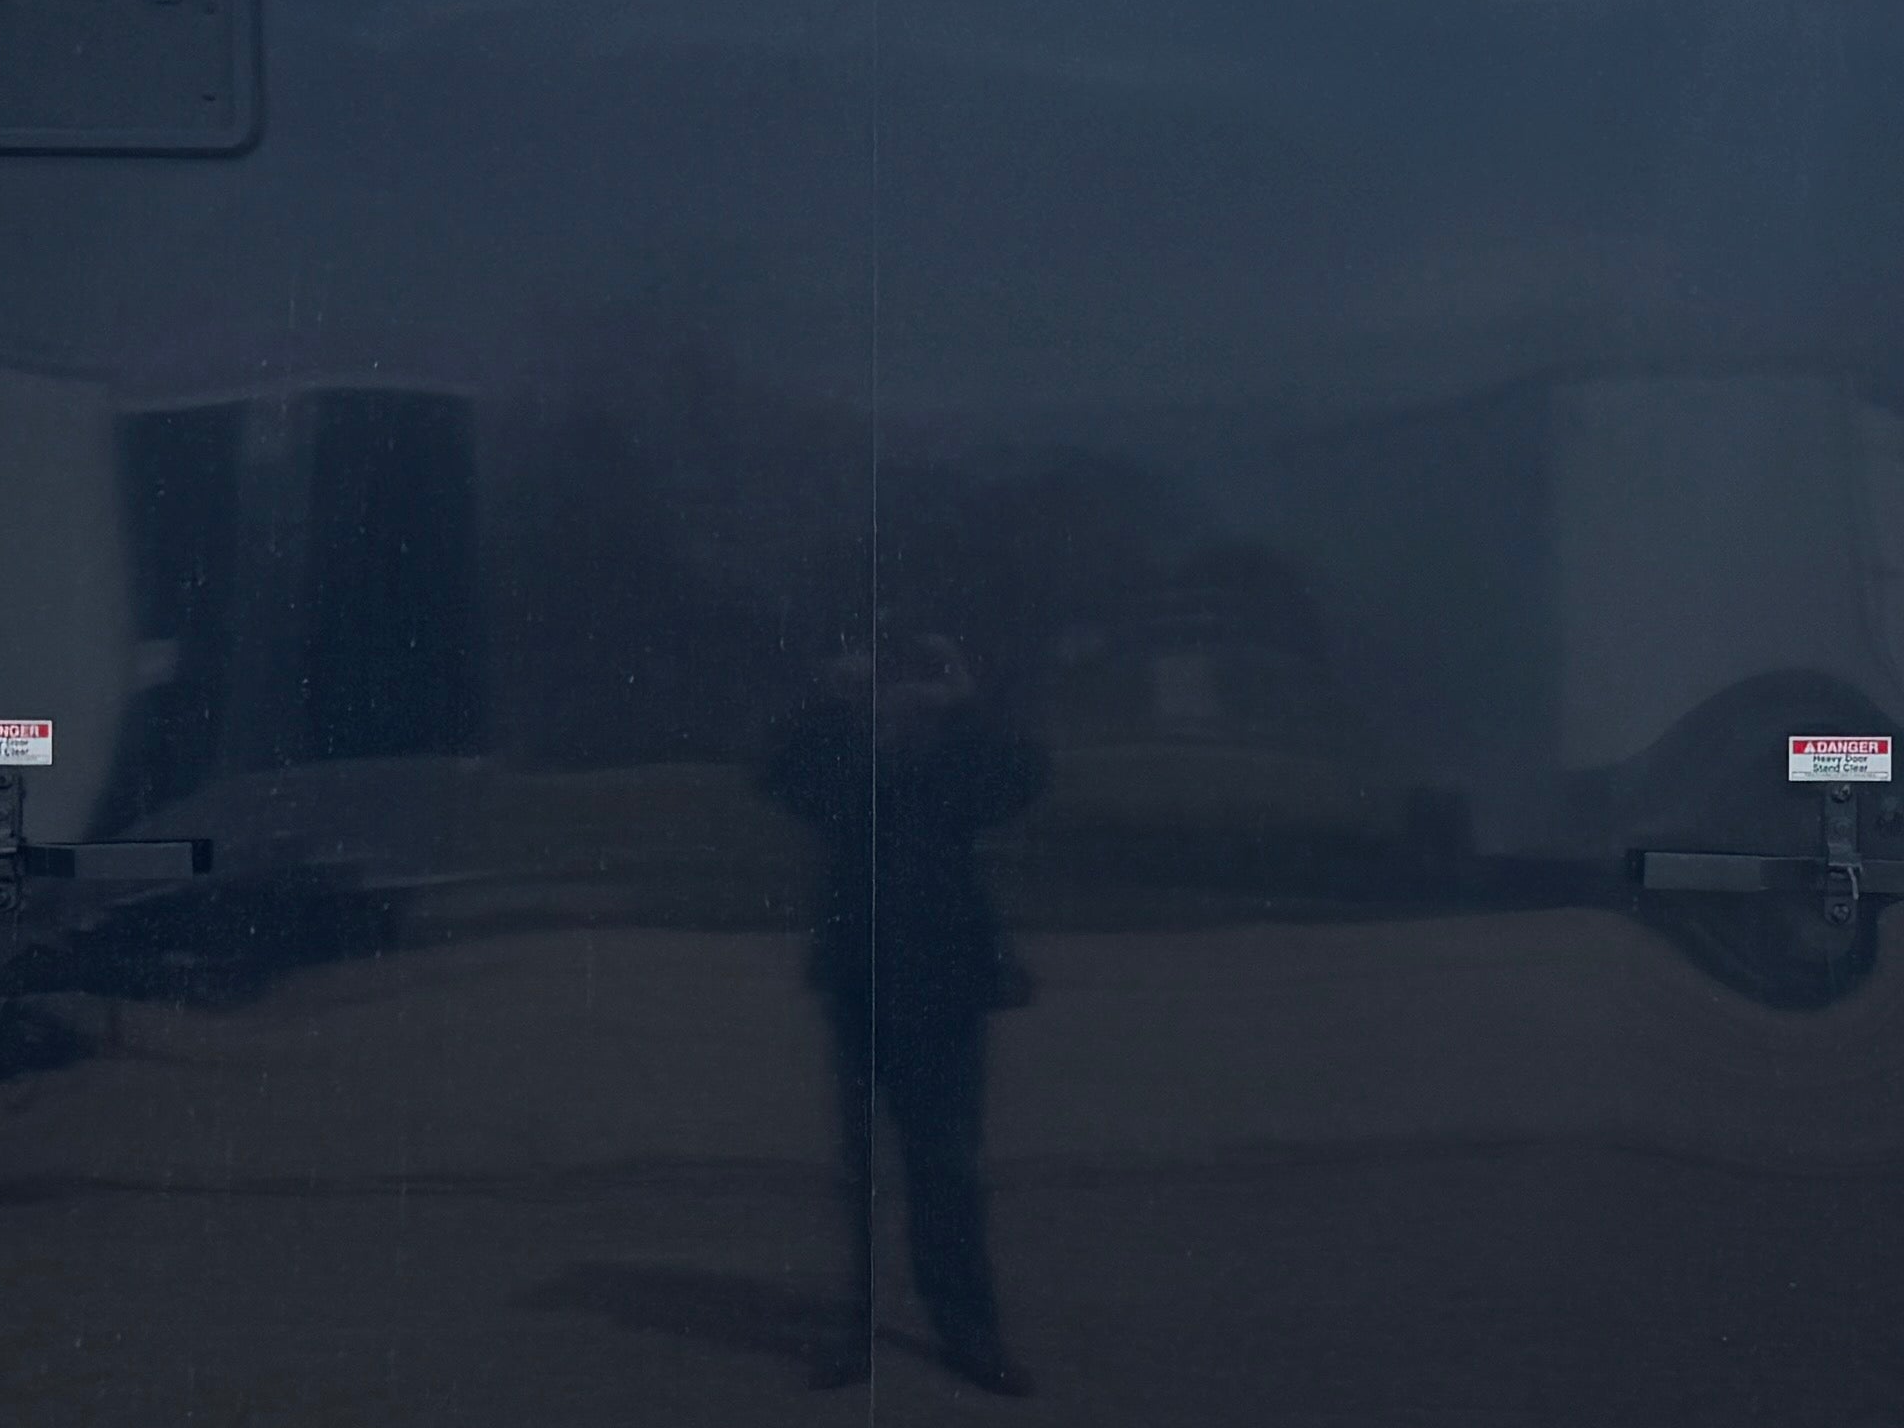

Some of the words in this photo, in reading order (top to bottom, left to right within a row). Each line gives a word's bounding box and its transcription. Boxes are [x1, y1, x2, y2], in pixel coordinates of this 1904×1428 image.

[1816, 741, 1879, 753] DANGER
[1813, 755, 1842, 765] Heavy
[1845, 754, 1868, 763] Door
[1843, 763, 1868, 772] Clear
